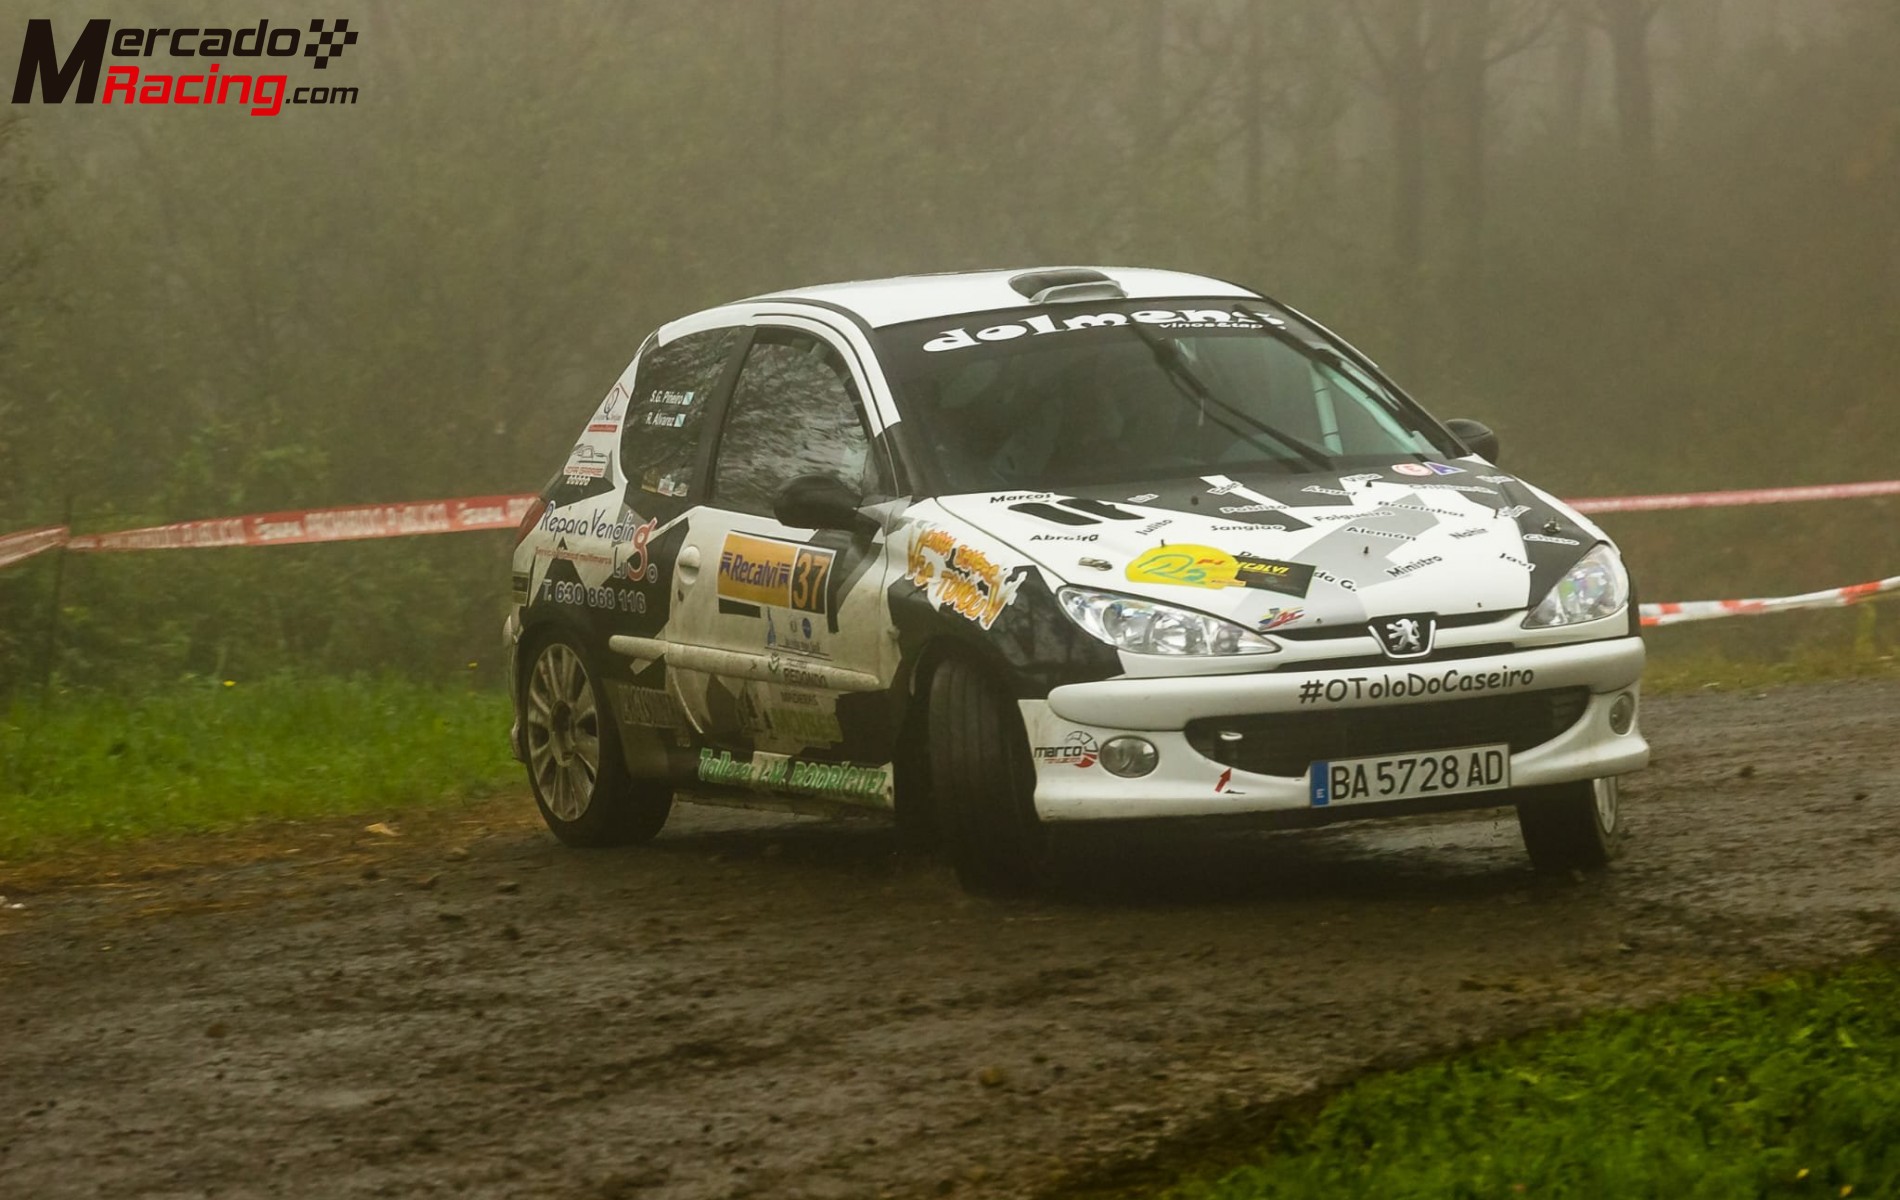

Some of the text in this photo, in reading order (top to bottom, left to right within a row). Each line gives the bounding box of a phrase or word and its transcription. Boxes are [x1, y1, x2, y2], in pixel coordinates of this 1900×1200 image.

[923, 309, 1285, 353] dolmens
[990, 493, 1051, 504] Marcos
[540, 500, 588, 541] Repara
[730, 554, 780, 588] Recalvi
[793, 552, 830, 611] 37
[1386, 555, 1443, 578] Ministro
[555, 580, 584, 605] 630
[587, 585, 616, 610] 868
[619, 588, 646, 614] 116
[1298, 665, 1534, 704] #OToloDoCaseiro
[1331, 750, 1503, 801] BA 5728 AD
